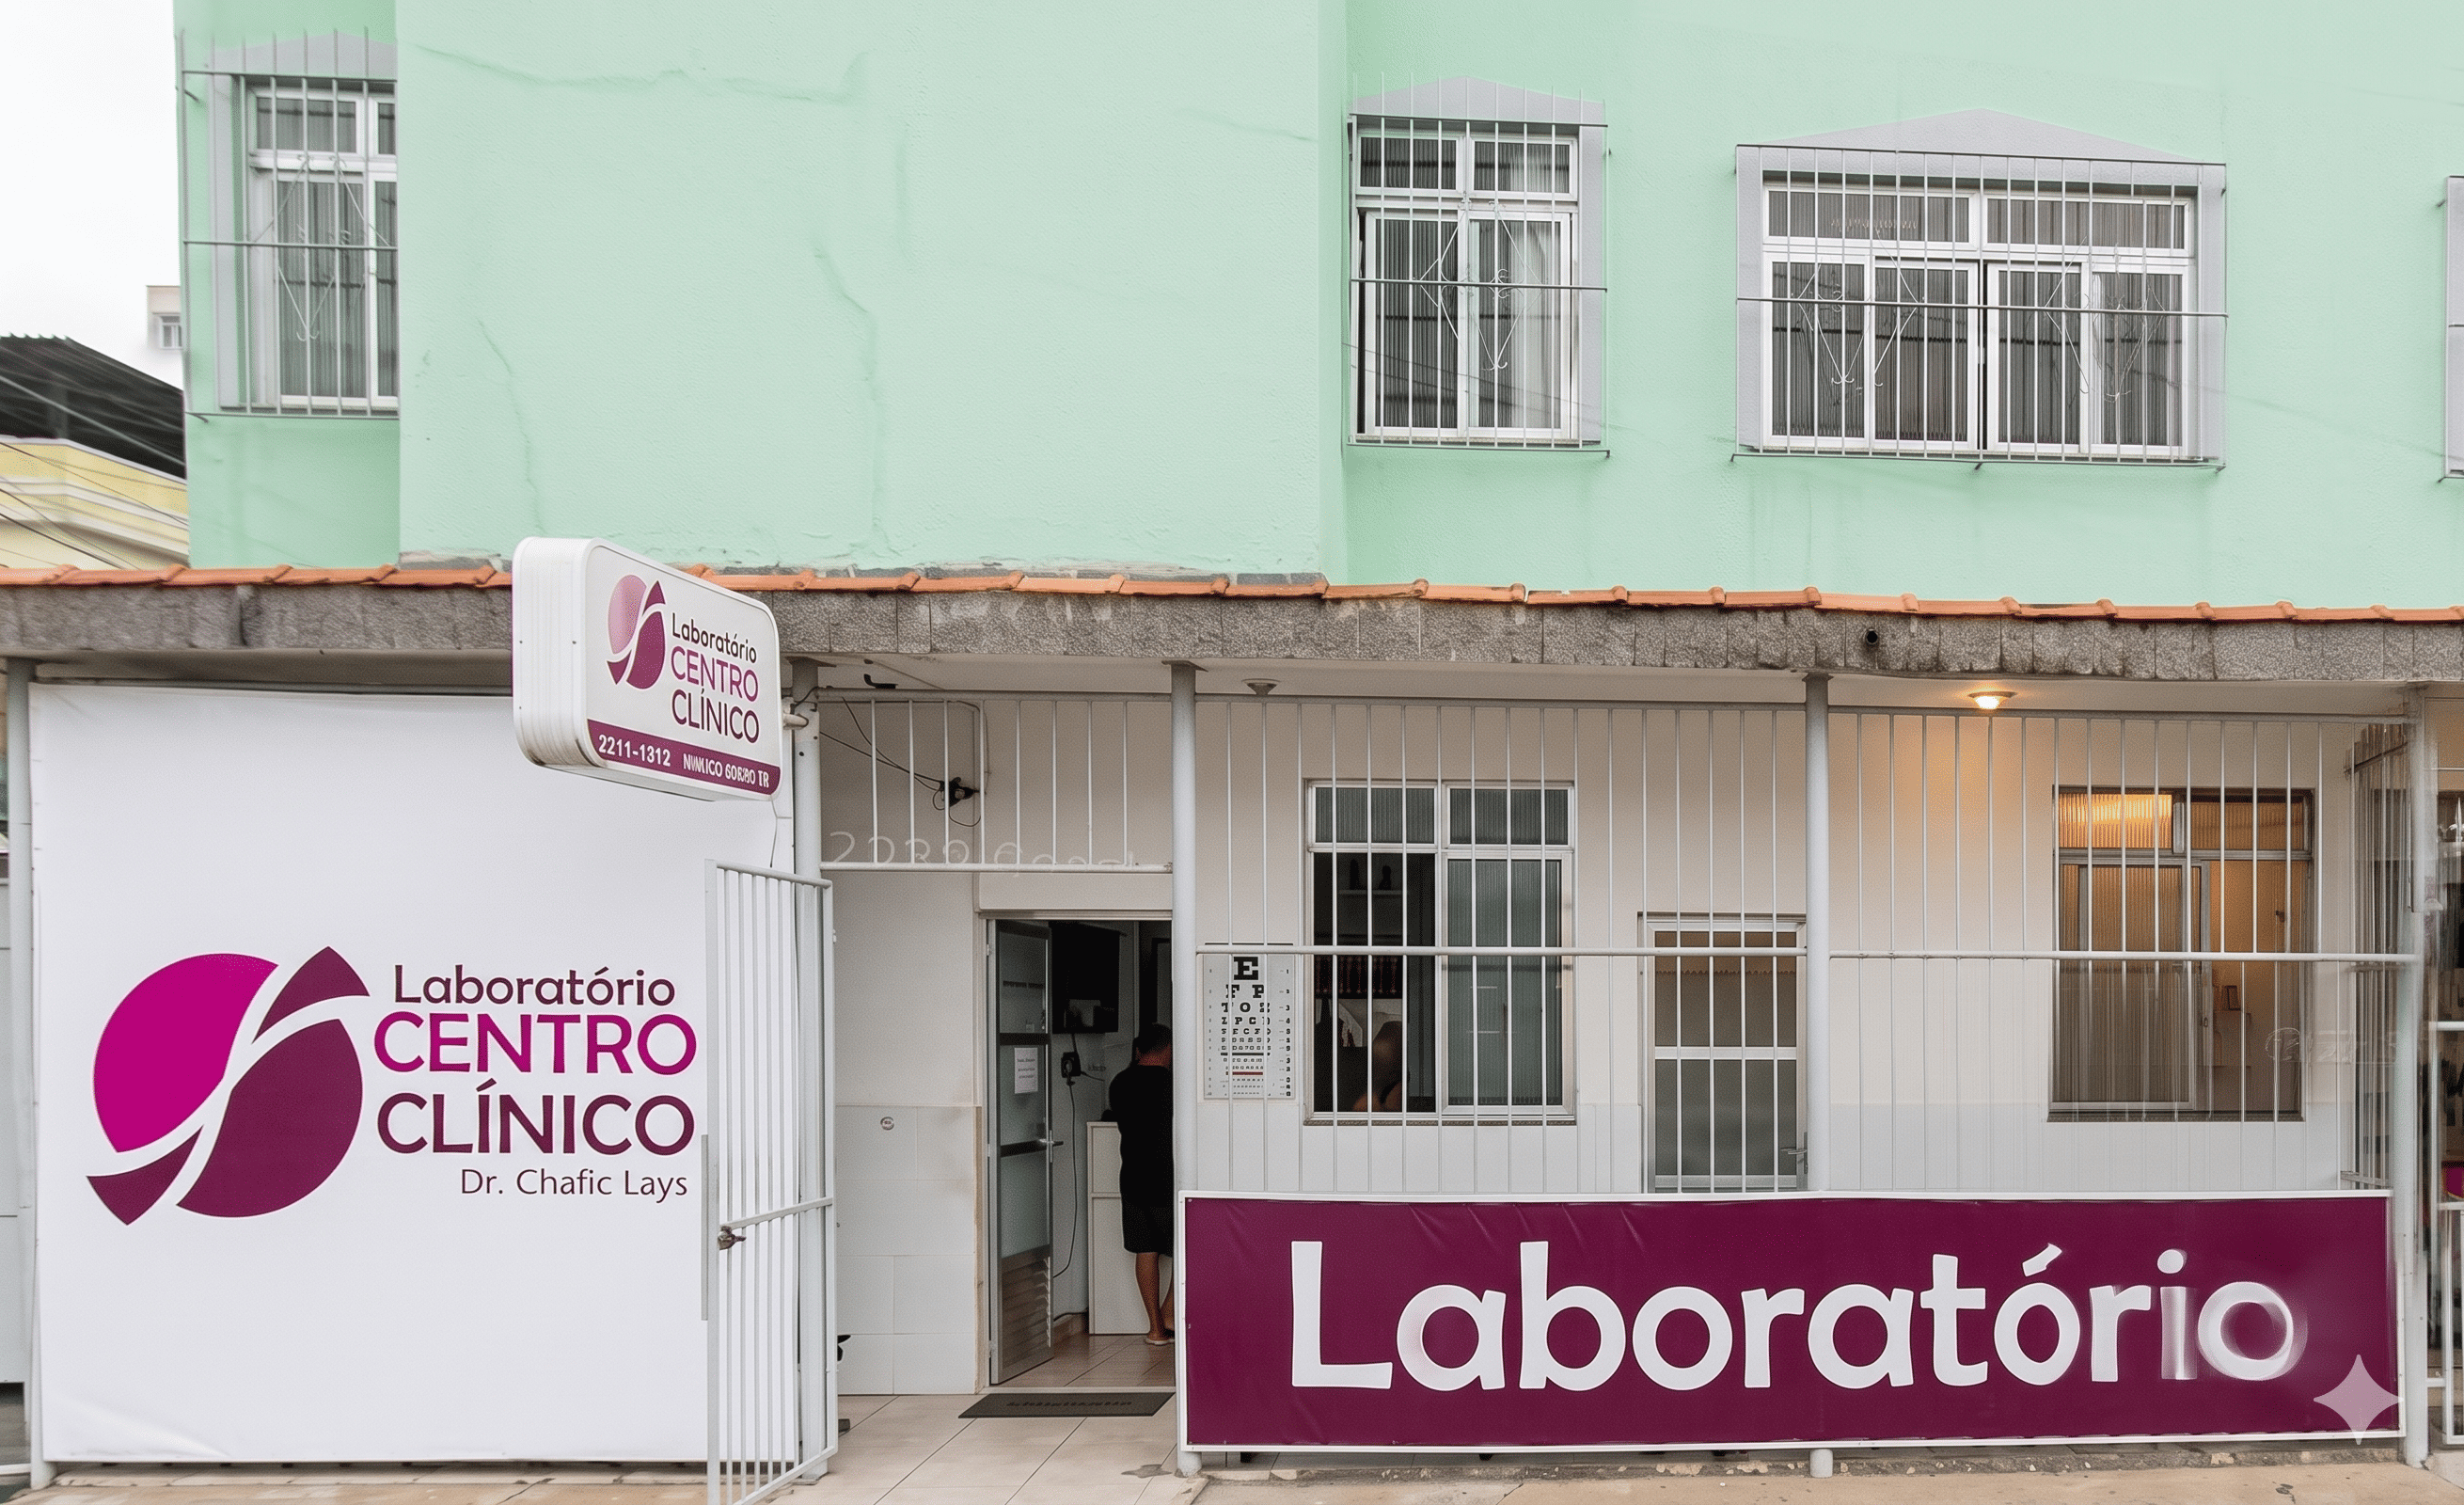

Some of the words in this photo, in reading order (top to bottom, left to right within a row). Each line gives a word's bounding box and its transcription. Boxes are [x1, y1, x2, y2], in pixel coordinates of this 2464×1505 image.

[671, 645, 759, 703] CENTRO
[671, 688, 760, 744] CLÍNICO
[598, 734, 671, 768] 2211-1312
[395, 964, 675, 1006] Laboratório
[1233, 956, 1259, 981] E
[373, 1010, 698, 1076] CENTRO
[376, 1077, 695, 1156] CLÍNICO
[461, 1168, 504, 1196] Dr.
[516, 1167, 612, 1196] Chafic
[624, 1169, 688, 1204] Lays
[1289, 1241, 2306, 1391] Laboratório
